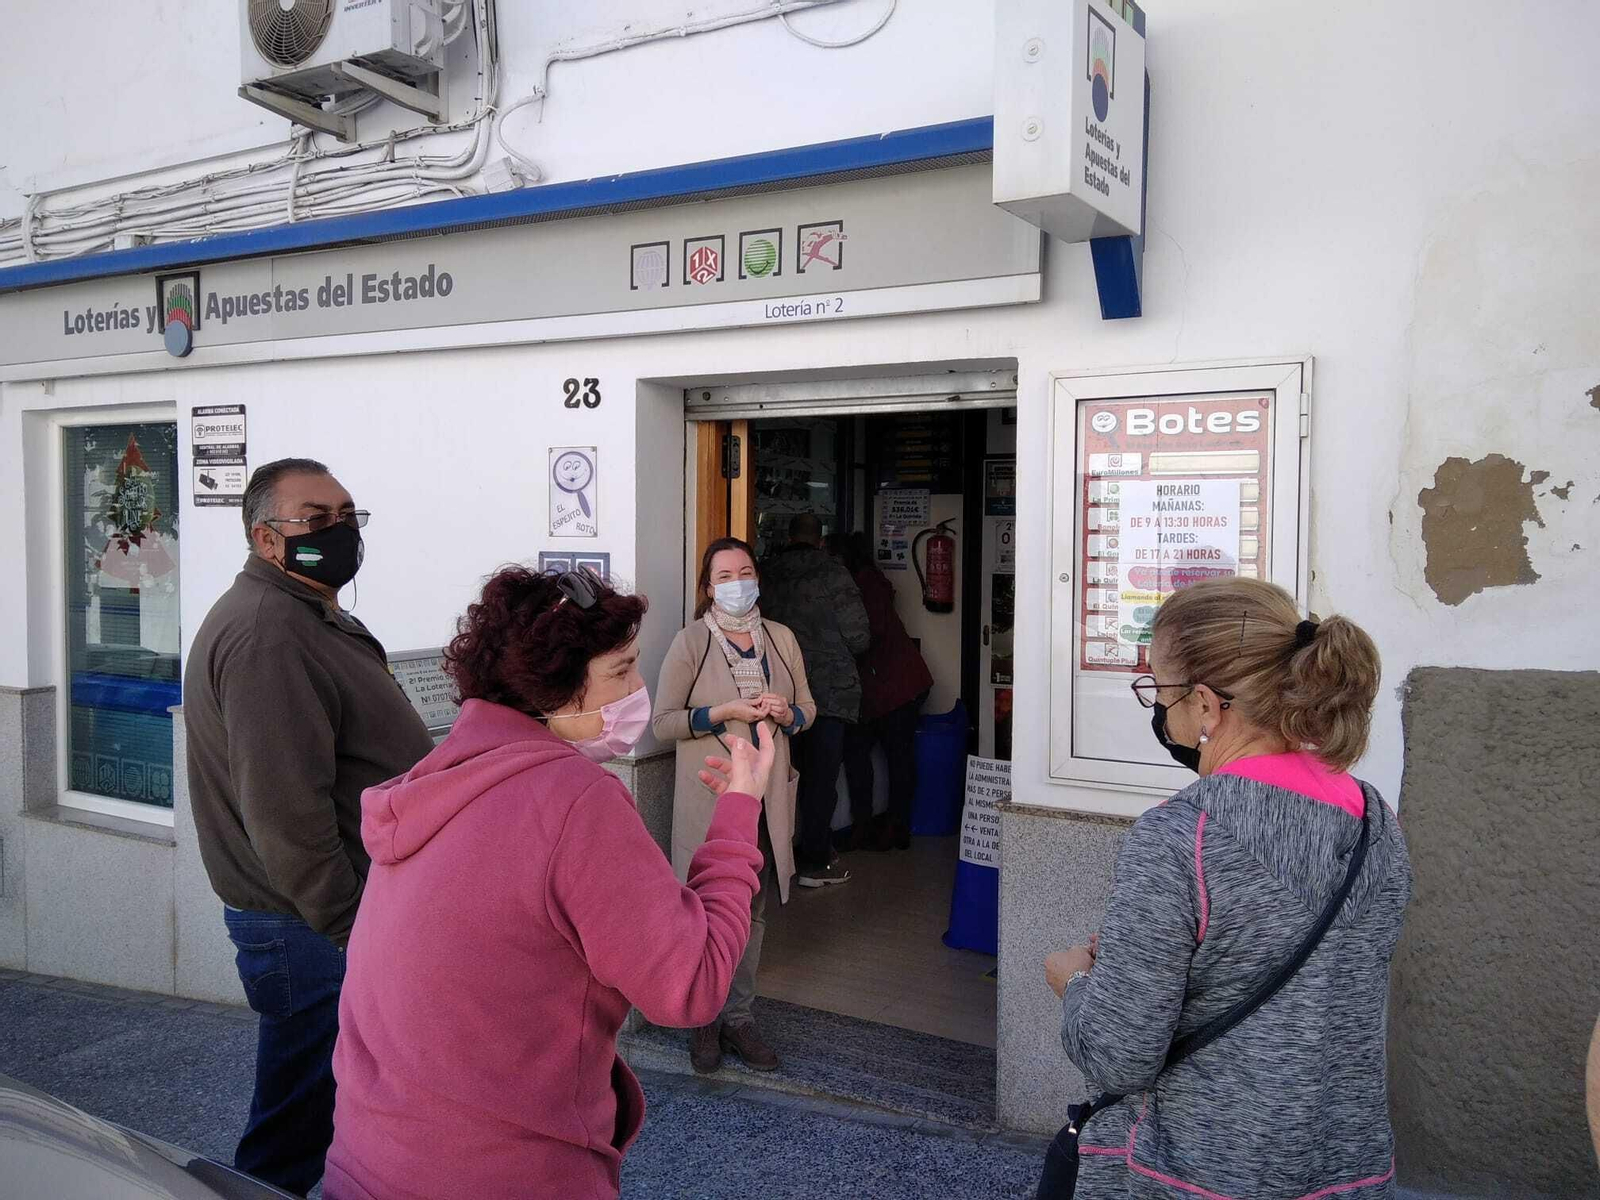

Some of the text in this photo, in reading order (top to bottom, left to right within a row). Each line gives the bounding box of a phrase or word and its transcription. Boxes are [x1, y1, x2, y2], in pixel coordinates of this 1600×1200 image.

[1085, 116, 1114, 152] Loterías
[1085, 142, 1130, 188] Apuestas del
[1085, 165, 1109, 196] Estado
[64, 264, 453, 335] Loterías y Apuestas del Estado
[765, 300, 812, 319] Lotería
[834, 297, 844, 313] 2
[563, 378, 602, 409] 23
[1126, 406, 1261, 436] Botes
[205, 424, 243, 432] PROTELEC
[1156, 484, 1201, 496] HORARIO
[557, 503, 565, 513] EL
[1152, 498, 1205, 512] MAÑANAS:
[553, 508, 582, 530] ESPEJITO
[1130, 516, 1228, 528] DE 9 A 13:30 HORAS
[576, 521, 595, 535] ROTO
[1098, 523, 1119, 531] Bonol
[1157, 533, 1199, 544] TARDES:
[1135, 549, 1221, 560] DE 17 A 21 HORAS
[1181, 569, 1221, 578] reservar
[1121, 593, 1153, 601] Llamando
[1121, 657, 1136, 665] Plus
[418, 675, 444, 683] Premio
[426, 683, 453, 691] Lotería
[976, 762, 993, 772] PUEDE
[974, 774, 1011, 787] ADMINISTRA
[977, 787, 985, 796] DE
[975, 799, 993, 810] MISM
[967, 811, 999, 824] UNA PERSO
[980, 827, 999, 837] VENTA
[963, 835, 975, 845] OTRA
[982, 840, 990, 849] LA
[964, 849, 993, 862] DEL LOCAL
